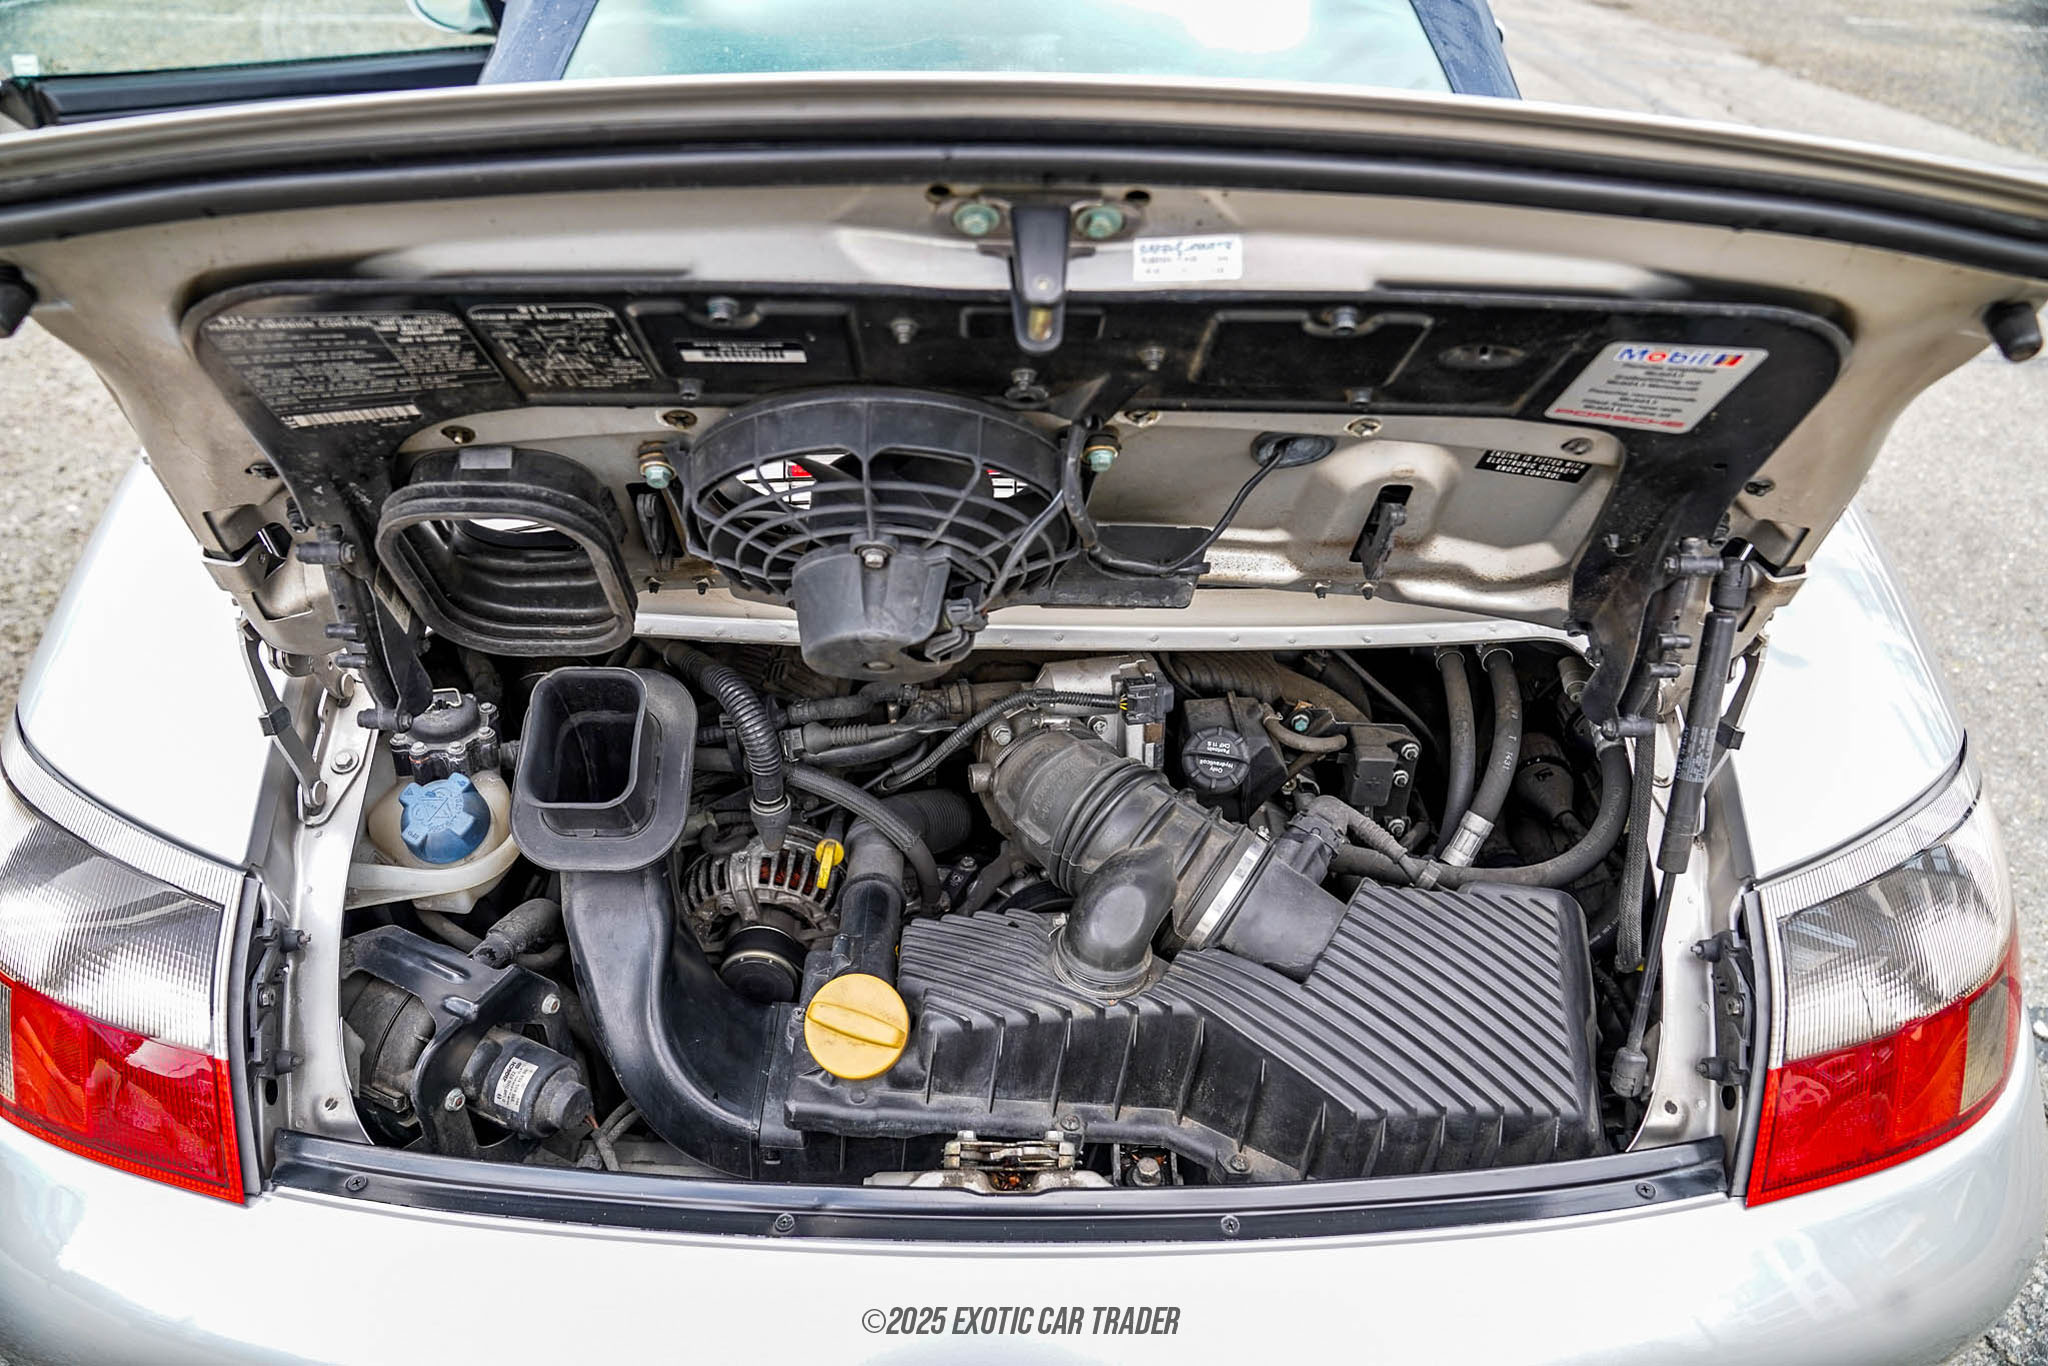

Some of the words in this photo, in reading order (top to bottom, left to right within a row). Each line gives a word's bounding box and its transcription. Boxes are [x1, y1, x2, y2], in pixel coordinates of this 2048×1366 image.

[1619, 348, 1711, 365] Mobil
[1485, 456, 1536, 469] ELECTRONIC
[1489, 450, 1521, 460] ENGINE
[1522, 454, 1533, 462] IS
[1533, 456, 1562, 466] FITTED
[1564, 460, 1587, 469] WITH
[1495, 464, 1523, 474] KNOCK
[1524, 468, 1561, 480] CONTROL
